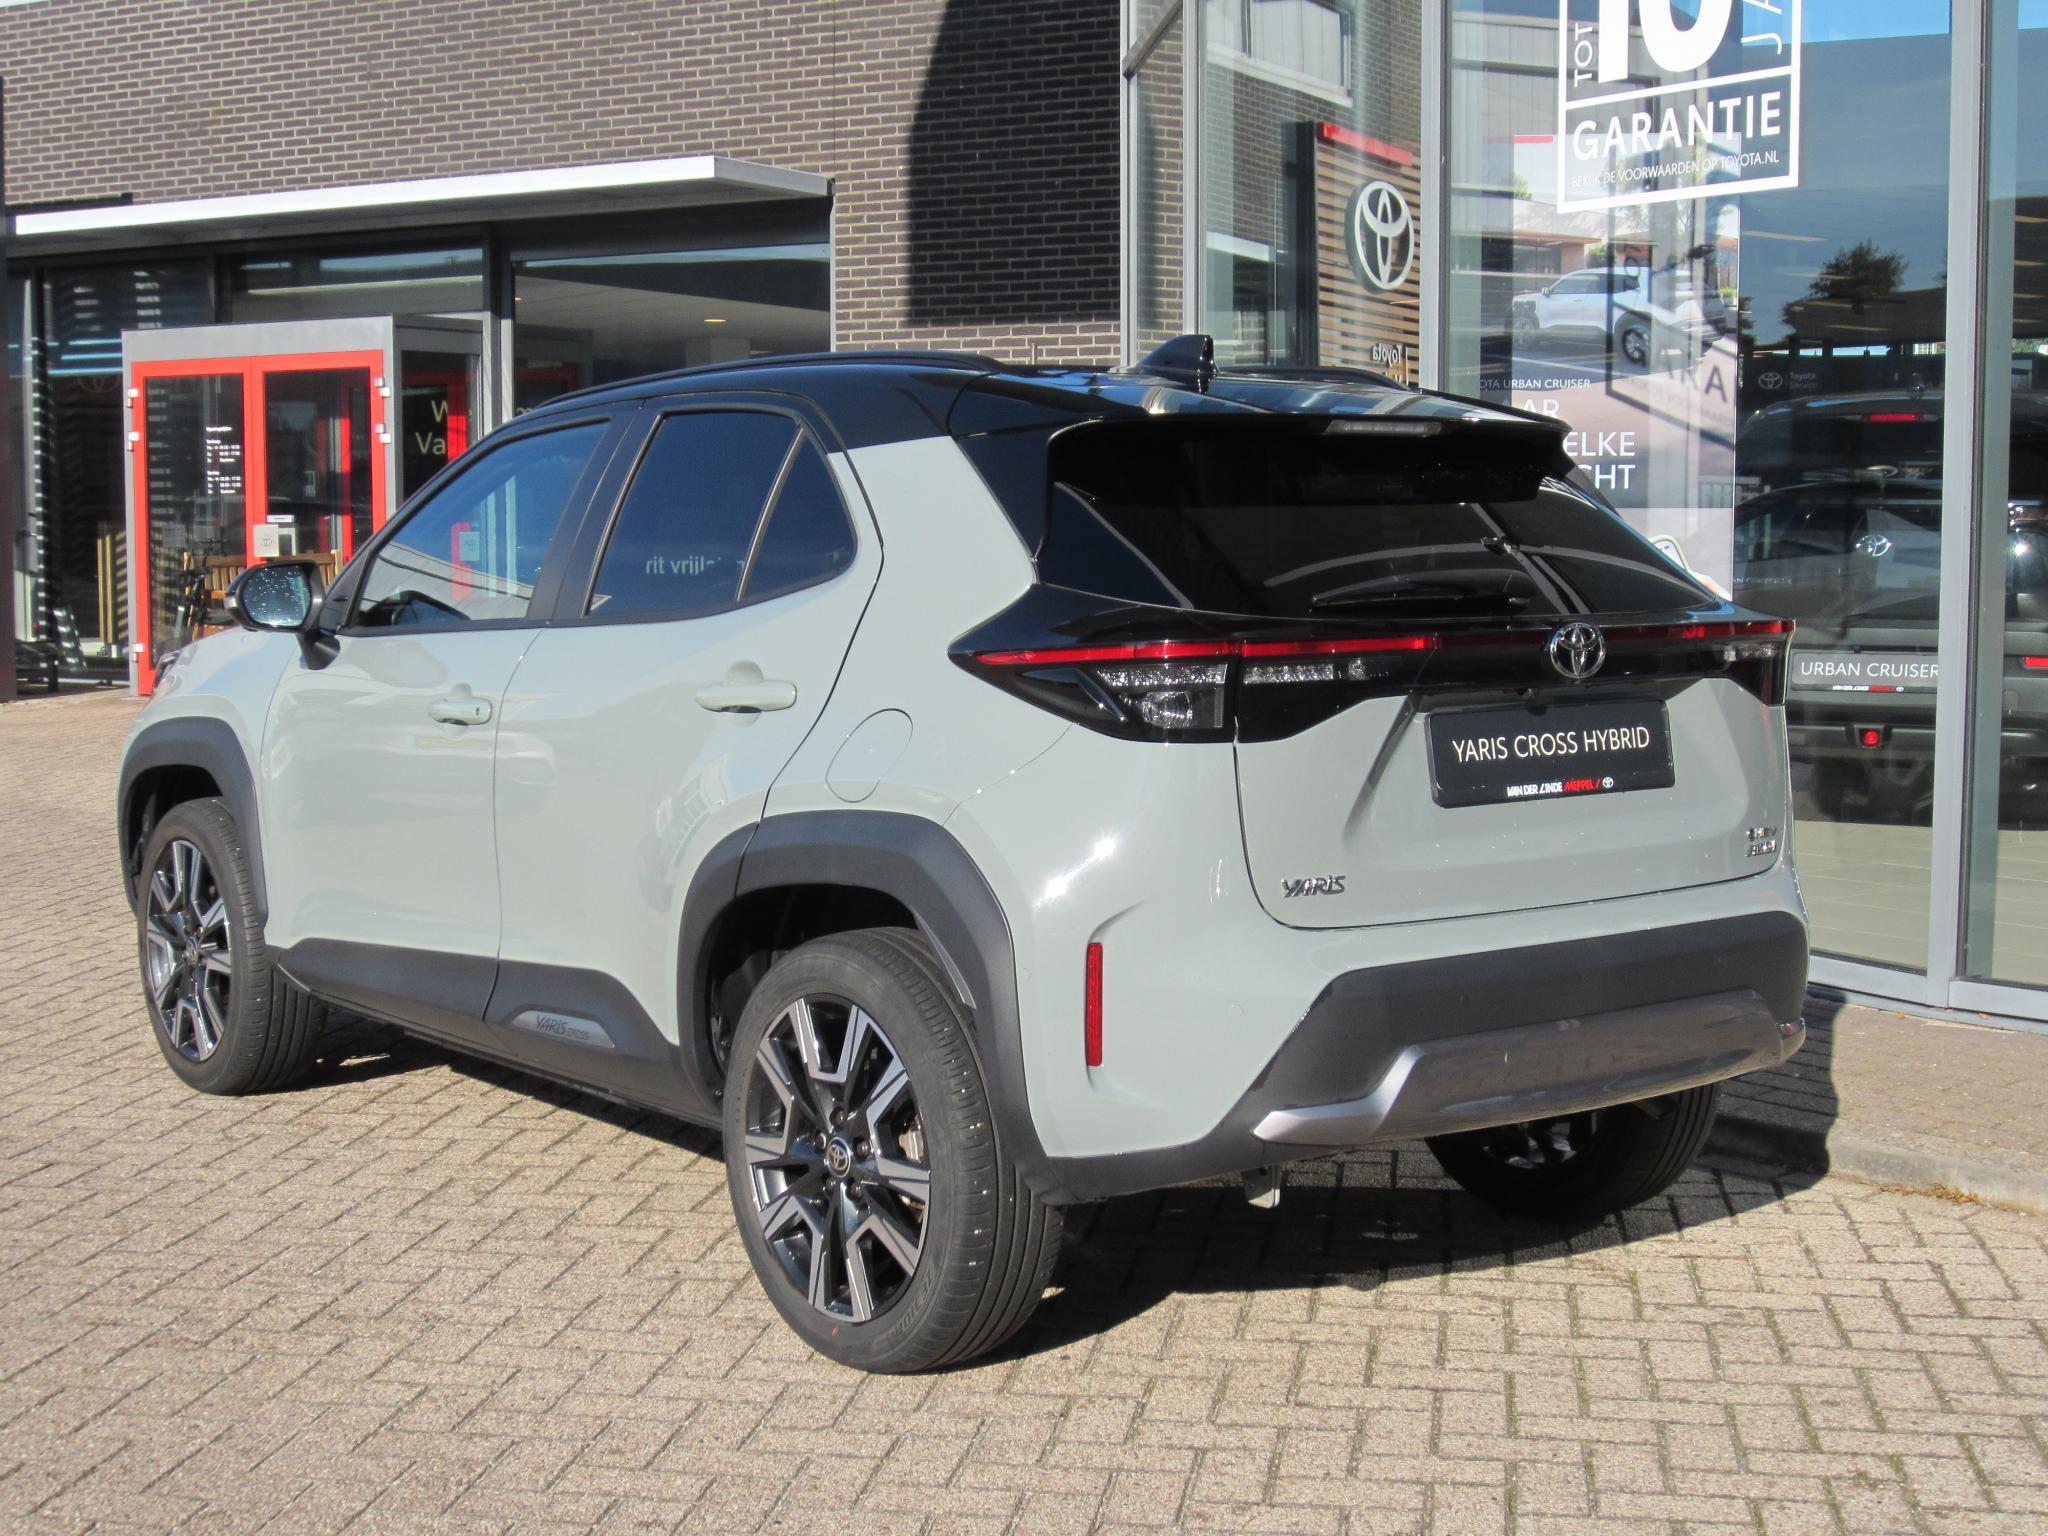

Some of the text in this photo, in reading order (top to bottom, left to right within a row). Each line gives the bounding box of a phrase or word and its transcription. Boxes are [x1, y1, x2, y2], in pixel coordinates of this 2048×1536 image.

[1574, 22, 1593, 88] TOT
[1572, 91, 1782, 161] GARANTIE
[1603, 171, 1617, 184] DE
[1619, 160, 1699, 182] VOORWAARDEN
[1703, 157, 1718, 171] OP
[1721, 149, 1780, 169] TOYOTA.NL
[1503, 378, 1541, 389] URBAN
[1545, 378, 1591, 389] CRUISER
[1506, 398, 1560, 418] AR
[1563, 431, 1636, 457] ELKE
[1801, 661, 1939, 679] URBAN CRUISER
[1452, 726, 1650, 763] YARIS CROSS HYBRID
[1506, 779, 1594, 797] VAN DER LINDE MEPPEL
[1280, 874, 1347, 898] YARIS
[536, 1014, 568, 1035] YARIS
